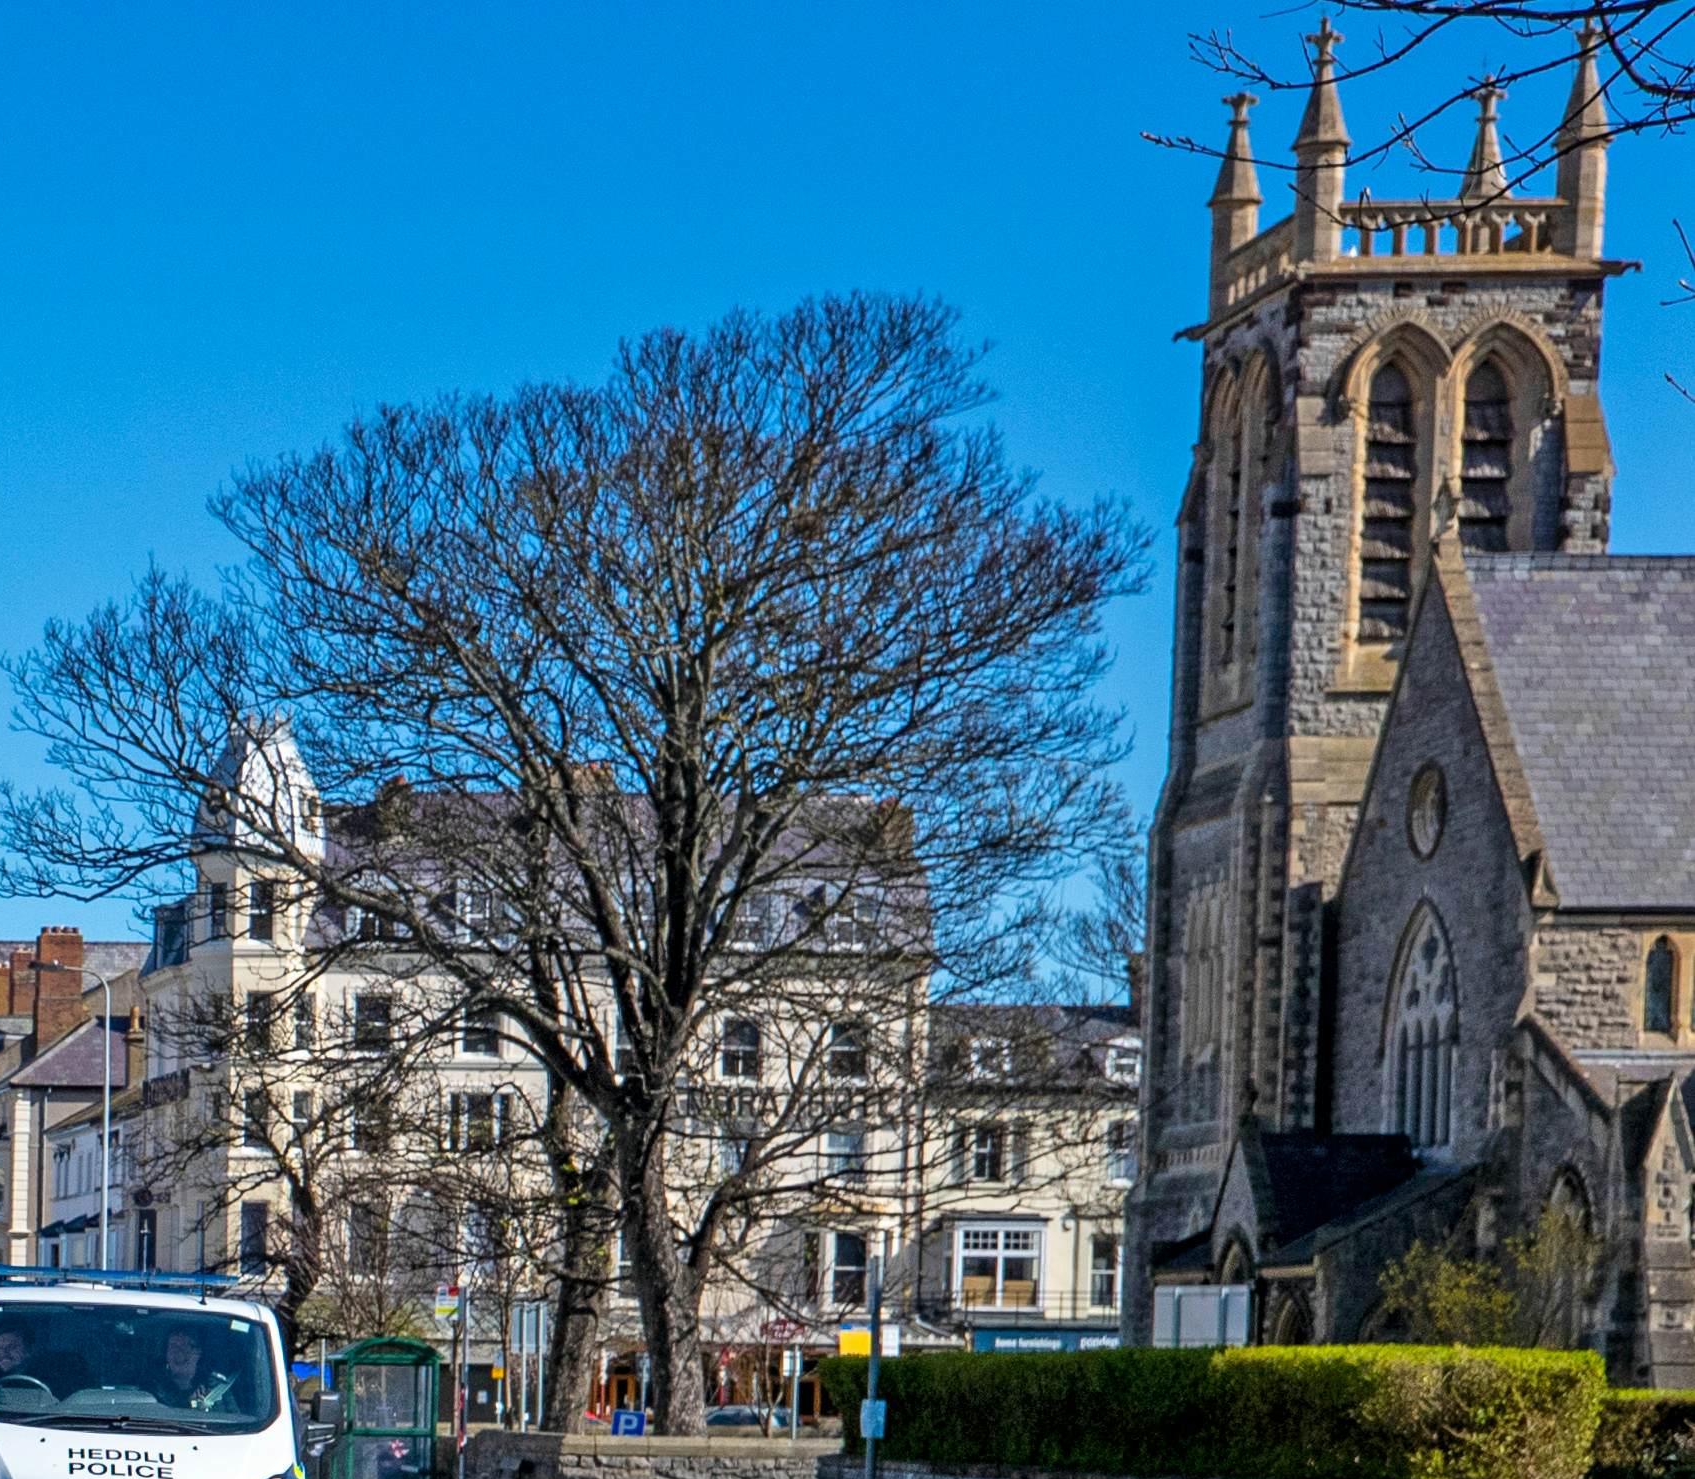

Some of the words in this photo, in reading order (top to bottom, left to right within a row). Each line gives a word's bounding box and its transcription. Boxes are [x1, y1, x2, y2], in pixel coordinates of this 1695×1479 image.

[618, 1413, 638, 1436] P
[67, 1448, 176, 1465] HEDDLU
[68, 1462, 174, 1479] POLICE
